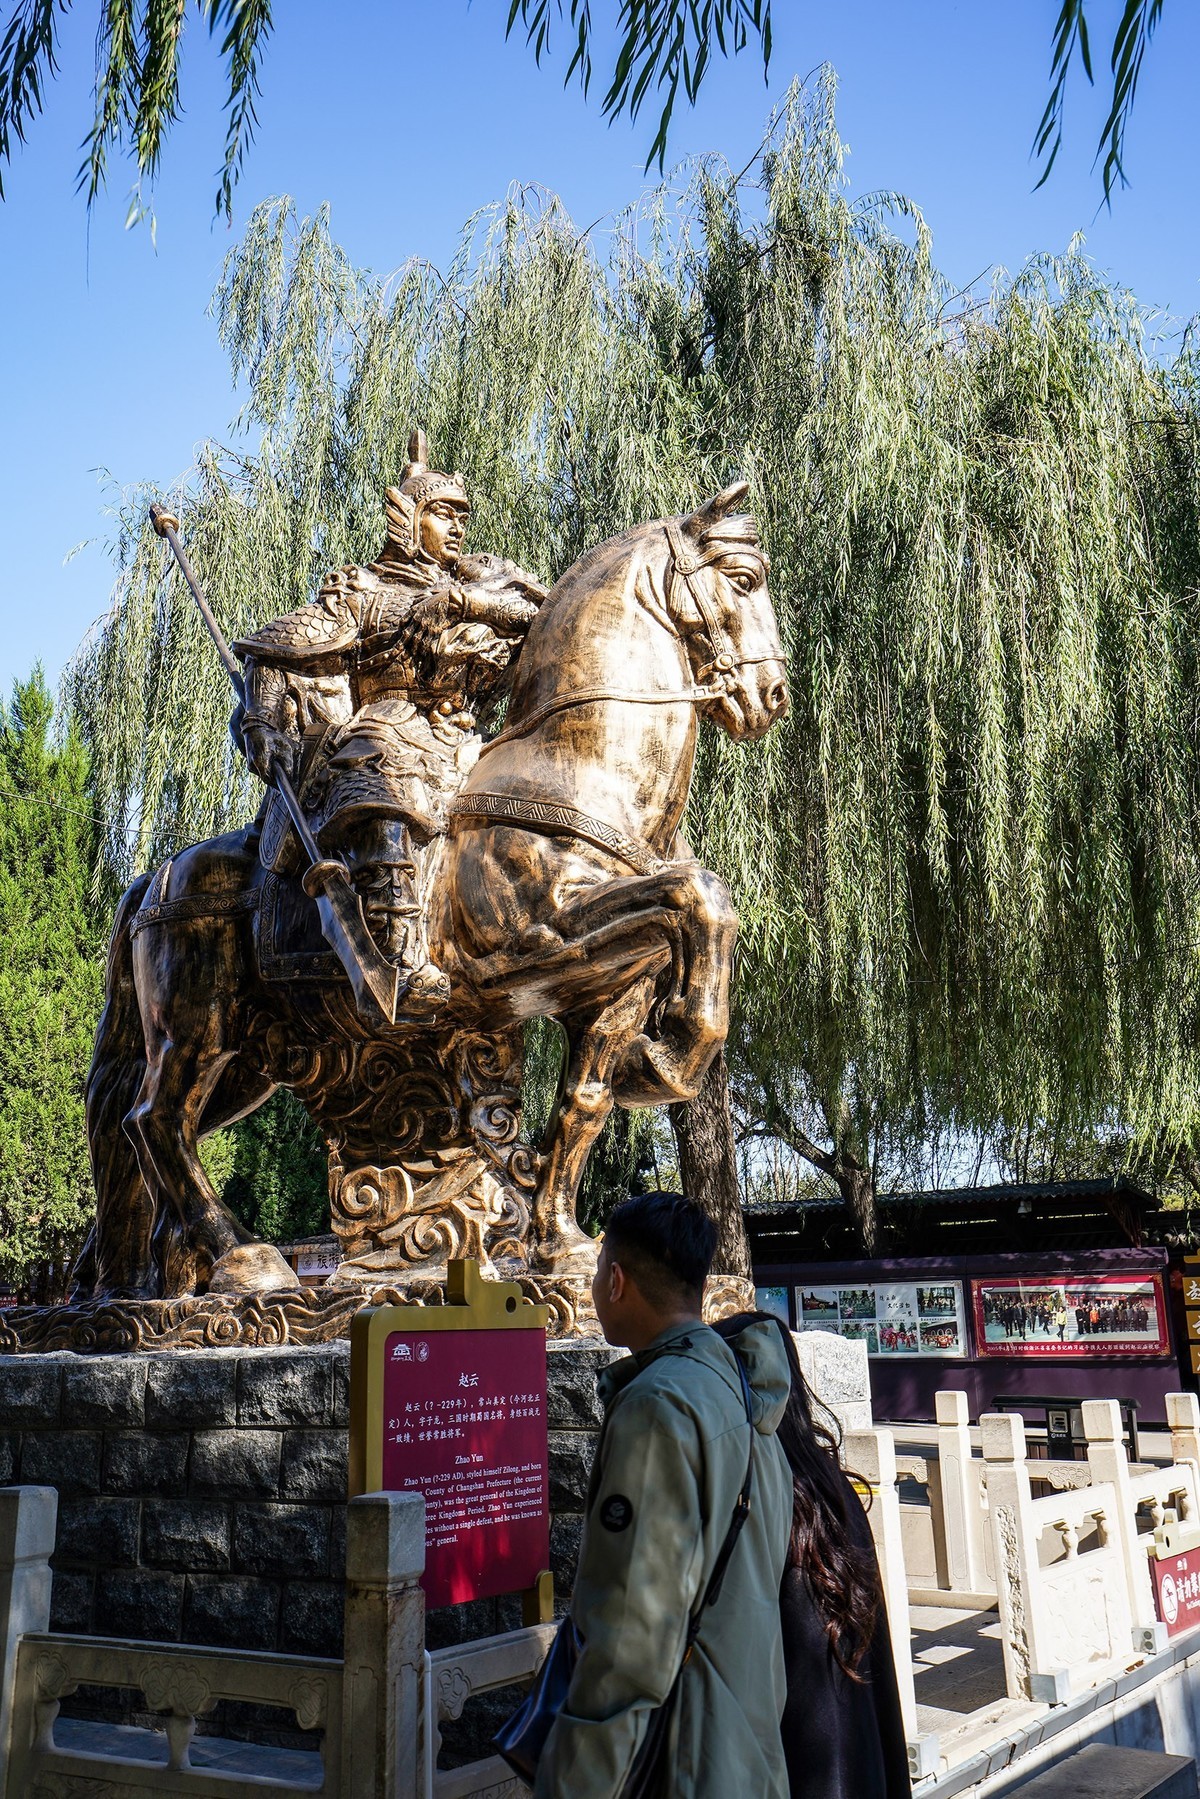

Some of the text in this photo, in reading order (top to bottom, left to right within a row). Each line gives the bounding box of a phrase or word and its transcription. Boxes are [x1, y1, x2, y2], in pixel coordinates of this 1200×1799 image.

[458, 1372, 480, 1388] 赵云
[455, 1454, 483, 1465] Zhao Yun
[404, 1478, 418, 1486] Zhao
[420, 1476, 431, 1484] Yun
[432, 1474, 451, 1484] (?-229
[452, 1472, 465, 1481] AD),
[466, 1470, 482, 1480] styled
[483, 1467, 502, 1476] himself
[521, 1464, 530, 1472] and
[425, 1487, 445, 1496] County
[448, 1485, 455, 1493] of
[456, 1483, 484, 1493] Changshan
[486, 1479, 512, 1488] Prefecture
[513, 1477, 523, 1485] (the
[455, 1496, 464, 1504] the
[465, 1495, 479, 1504] great
[479, 1492, 498, 1502] general
[506, 1488, 514, 1496] the
[514, 1487, 536, 1497] Kingdom
[438, 1510, 466, 1520] Kingdoms
[488, 1504, 501, 1512] Zhao
[502, 1502, 513, 1510] Yun
[514, 1497, 543, 1508] experienced
[434, 1524, 455, 1533] without
[460, 1520, 476, 1530] single
[477, 1517, 494, 1526] defeat,
[494, 1515, 504, 1523] and
[504, 1514, 511, 1522] he
[521, 1511, 537, 1519] known
[436, 1534, 459, 1547] general.
[1176, 1571, 1200, 1603] 请勿攀
